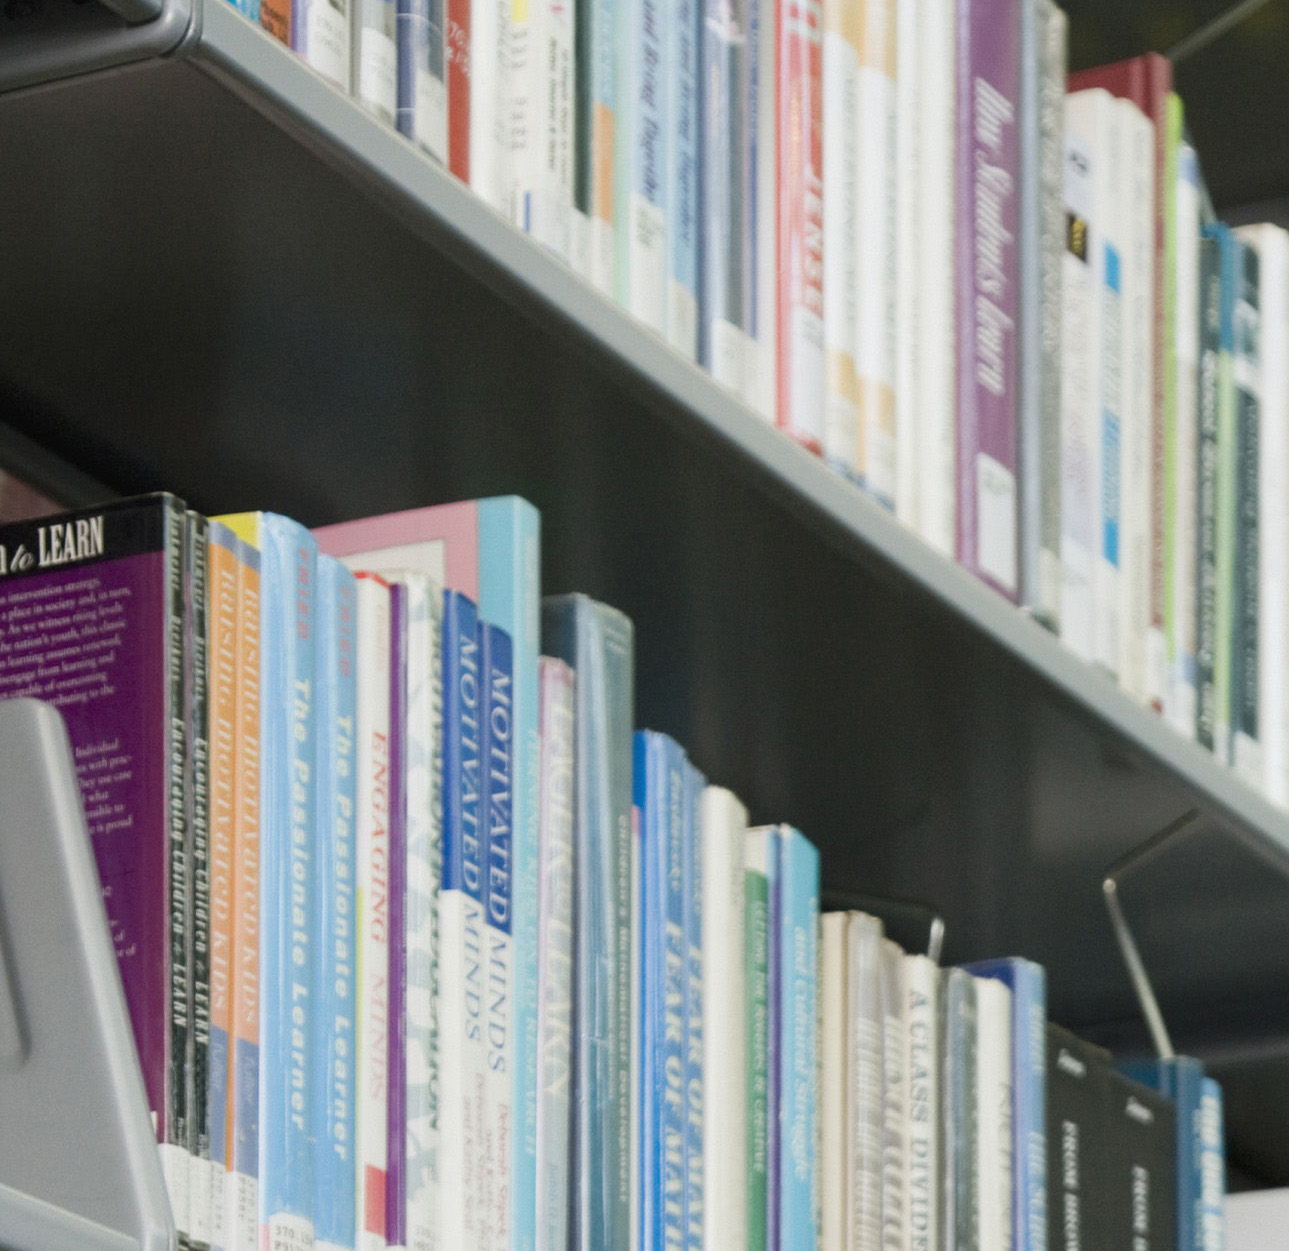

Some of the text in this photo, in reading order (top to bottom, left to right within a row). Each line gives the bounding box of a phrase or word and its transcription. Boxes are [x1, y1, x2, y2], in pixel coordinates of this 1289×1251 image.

[976, 149, 1015, 295] Students
[10, 515, 104, 571] to LEARN
[8, 583, 62, 604] intervention
[8, 606, 31, 621] place
[33, 604, 42, 614] in
[8, 653, 44, 669] learning
[23, 624, 36, 633] we
[37, 664, 60, 677] from
[62, 657, 97, 673] learning
[75, 738, 119, 757] Individual
[89, 758, 110, 772] with
[106, 816, 133, 835] proud
[460, 635, 480, 1042] MOTIVATED MINDS
[171, 717, 187, 1027] Encouraging Children LEARN
[193, 737, 209, 1044] Encouraging Children LEARN
[291, 679, 311, 1130] The Passionate Learner
[488, 668, 511, 1074] MOTIVATED MINDS
[333, 715, 354, 1160] The Passionate Learner
[370, 731, 387, 1101] ENGAGING MINDS
[664, 921, 682, 1043] FEAR
[688, 944, 703, 1063] FEAR
[910, 988, 930, 1010] A
[794, 978, 808, 1073] Cultural
[664, 1056, 682, 1109] OF
[688, 1078, 703, 1130] OF
[910, 1021, 930, 1123] CLASS
[1062, 1120, 1078, 1189] FROM
[1132, 1166, 1149, 1232] FROM
